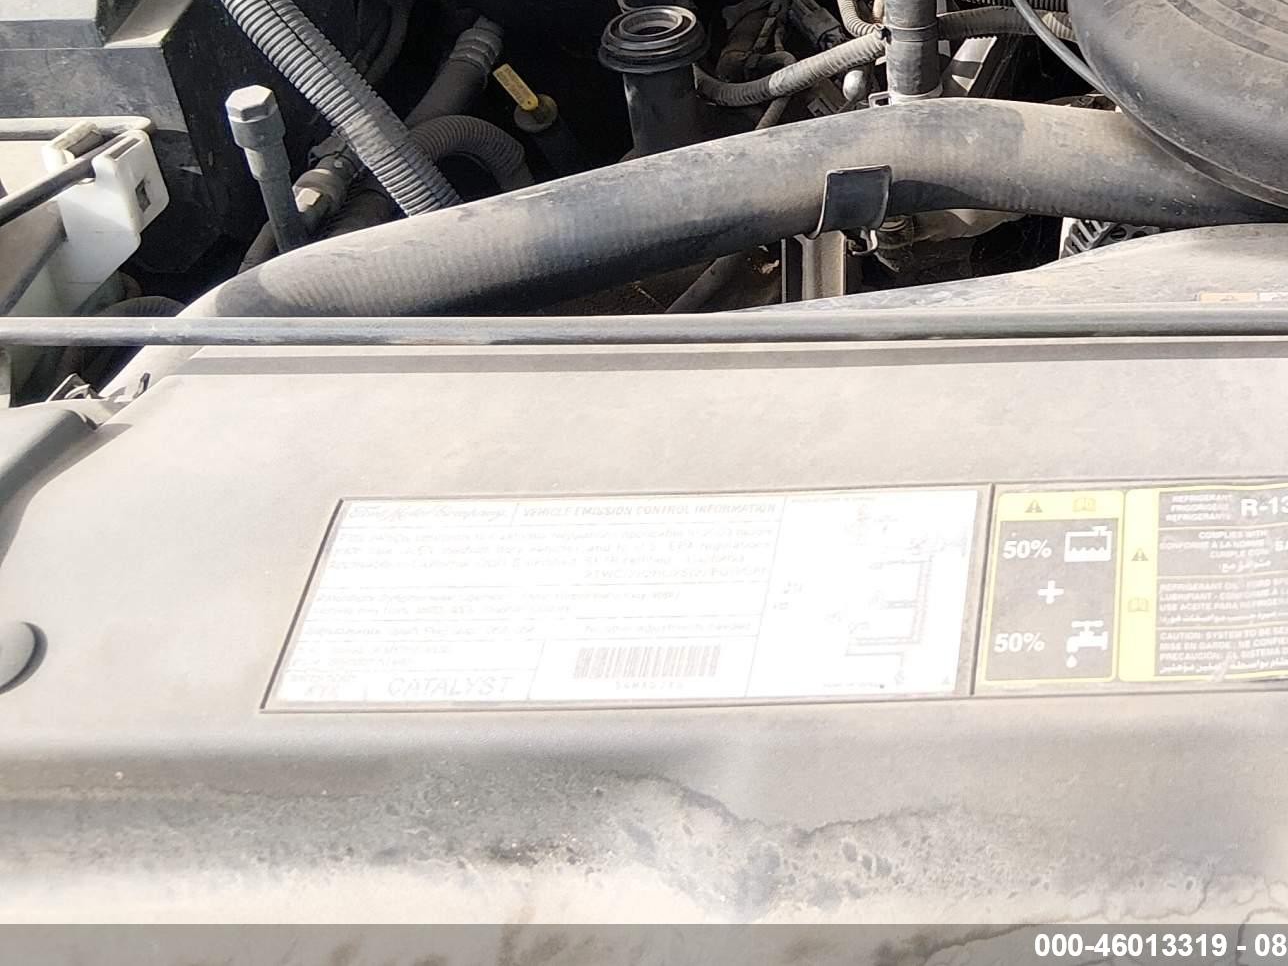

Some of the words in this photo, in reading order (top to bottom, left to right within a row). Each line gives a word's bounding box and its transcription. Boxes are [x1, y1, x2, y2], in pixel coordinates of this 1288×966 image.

[524, 505, 570, 517] VEHICLE
[576, 504, 633, 516] EMISSION
[637, 503, 689, 516] CONTROL
[695, 502, 777, 515] INFORMATION
[1002, 538, 1052, 559] 50%
[993, 632, 1045, 653] 50%
[388, 676, 513, 699] CATALYST
